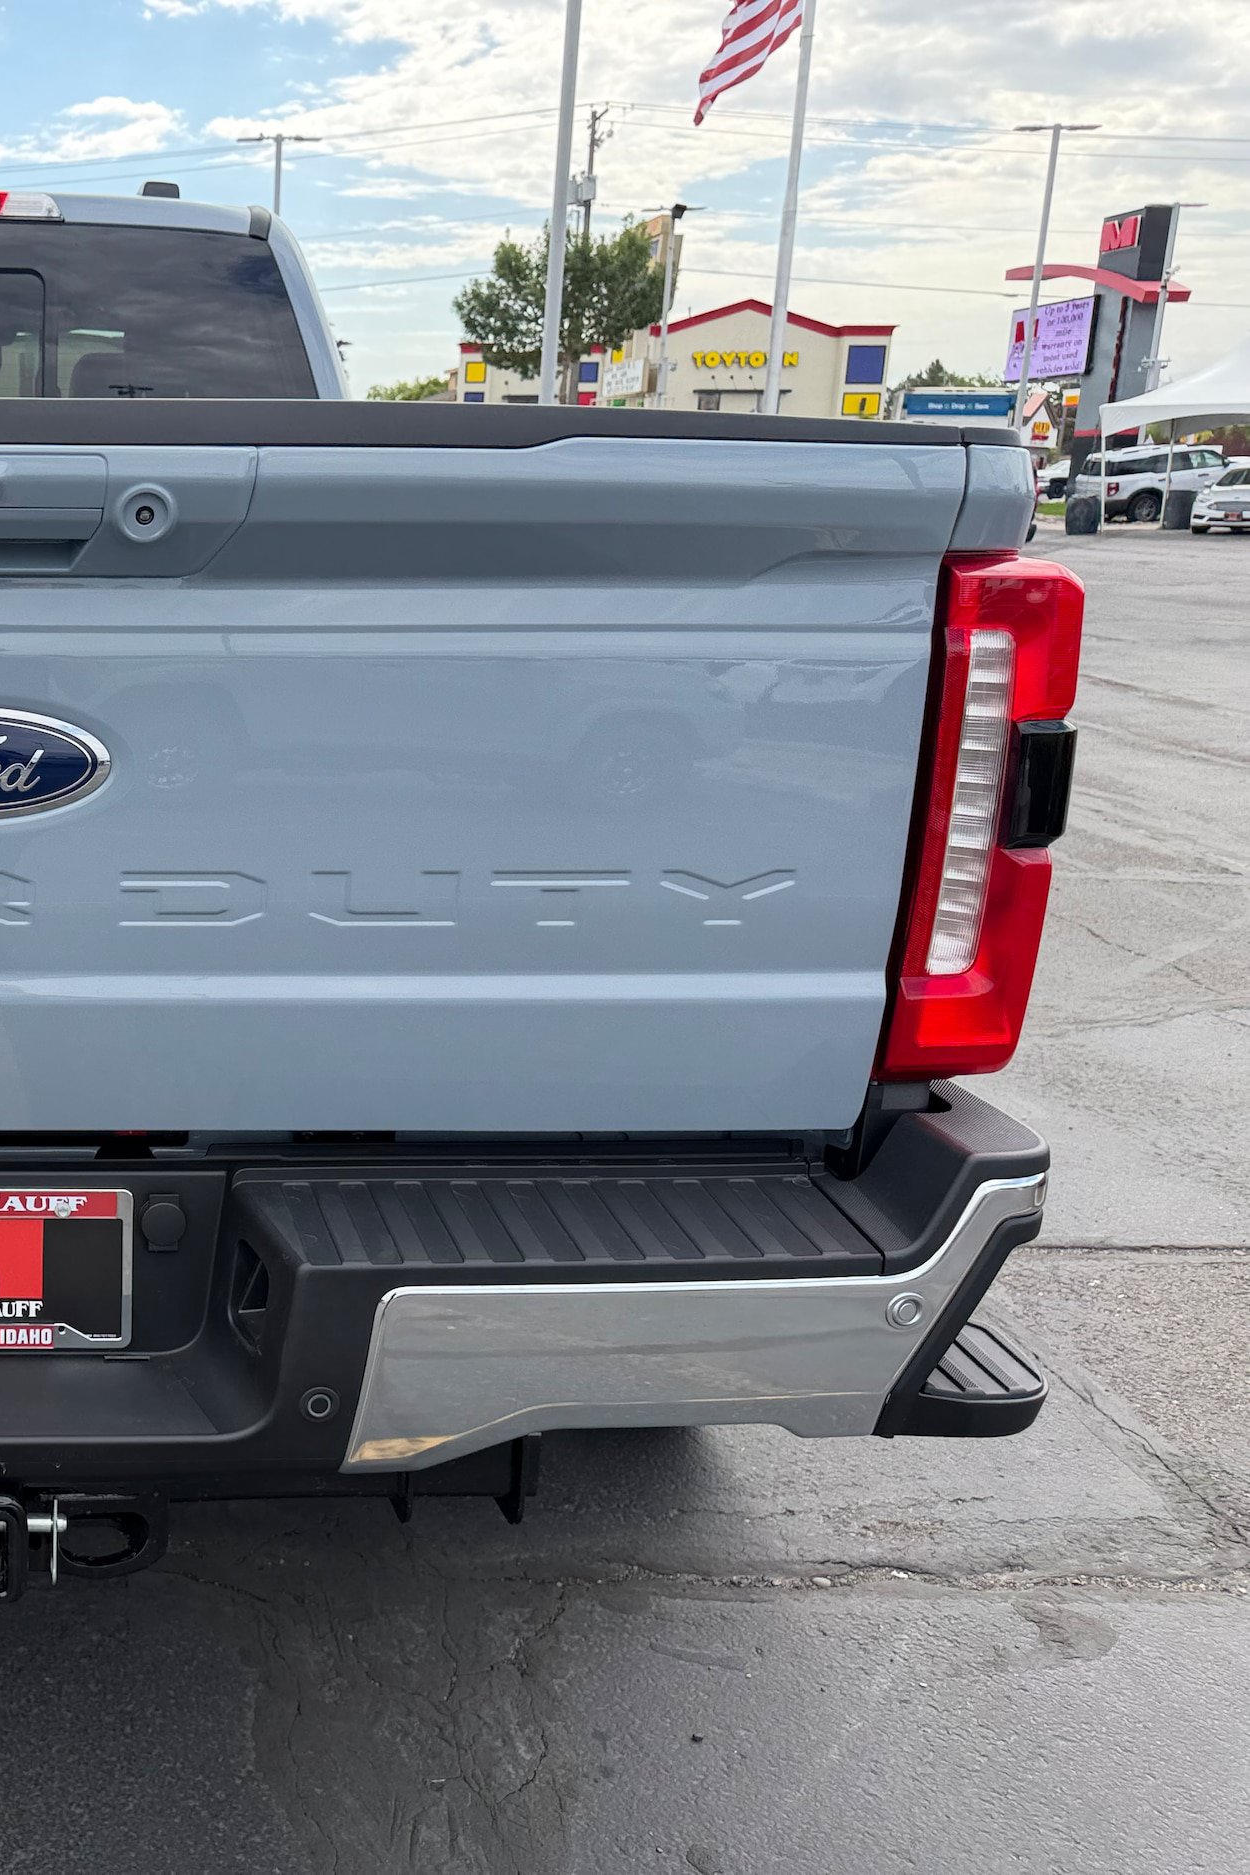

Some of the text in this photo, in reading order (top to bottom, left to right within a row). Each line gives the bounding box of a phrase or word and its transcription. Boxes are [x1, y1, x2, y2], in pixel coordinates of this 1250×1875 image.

[692, 350, 799, 369] TOYTON
[119, 869, 796, 927] DUTY
[0, 1328, 53, 1345] IDAHO
